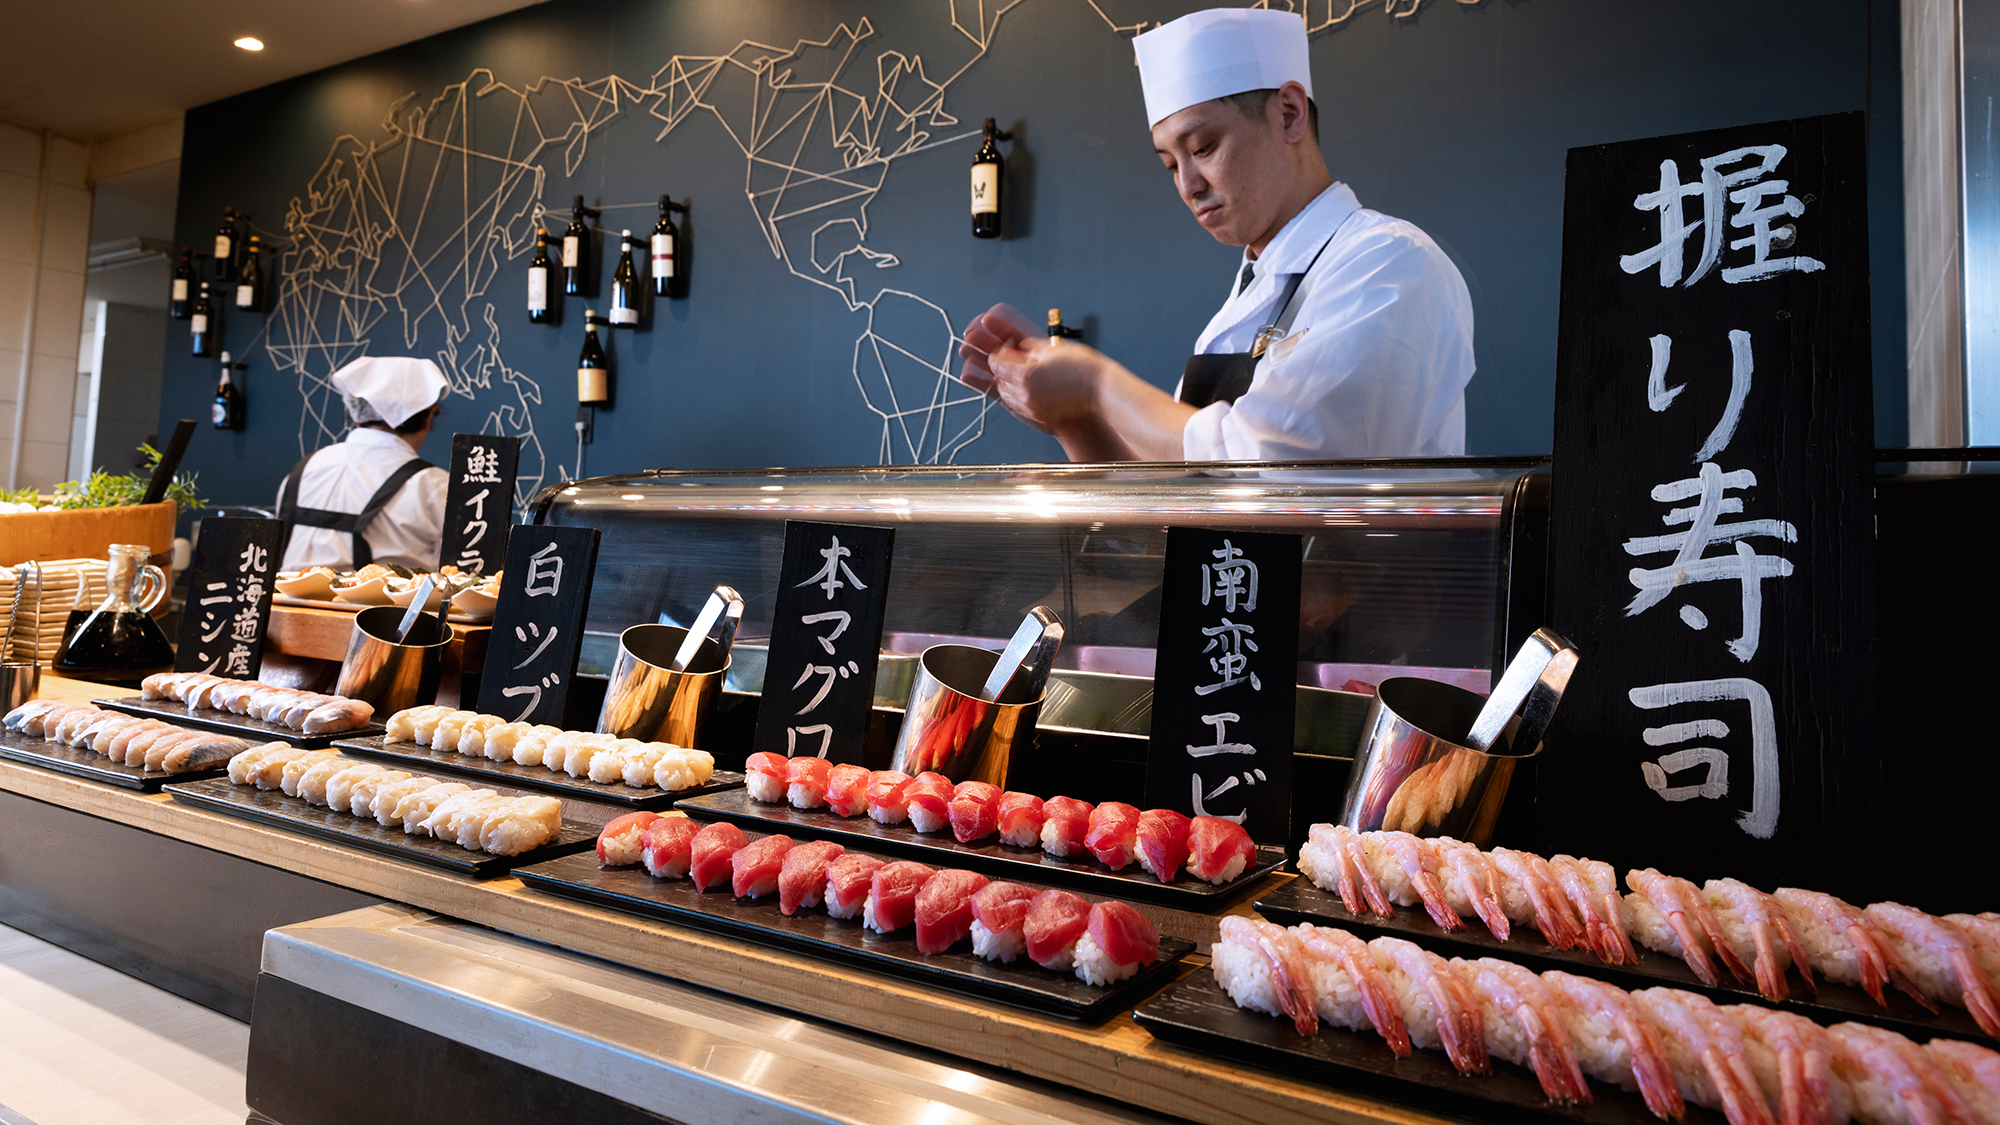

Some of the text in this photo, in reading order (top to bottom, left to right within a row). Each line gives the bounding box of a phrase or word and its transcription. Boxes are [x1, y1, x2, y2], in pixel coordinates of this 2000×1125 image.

[457, 445, 502, 576] 鮭イクラ
[1619, 144, 1826, 840] 握り寿司
[195, 582, 233, 675] ニシン
[225, 543, 268, 676] 北海道産
[502, 541, 564, 723] 白ツブ
[1186, 539, 1266, 825] 南蛮エビ
